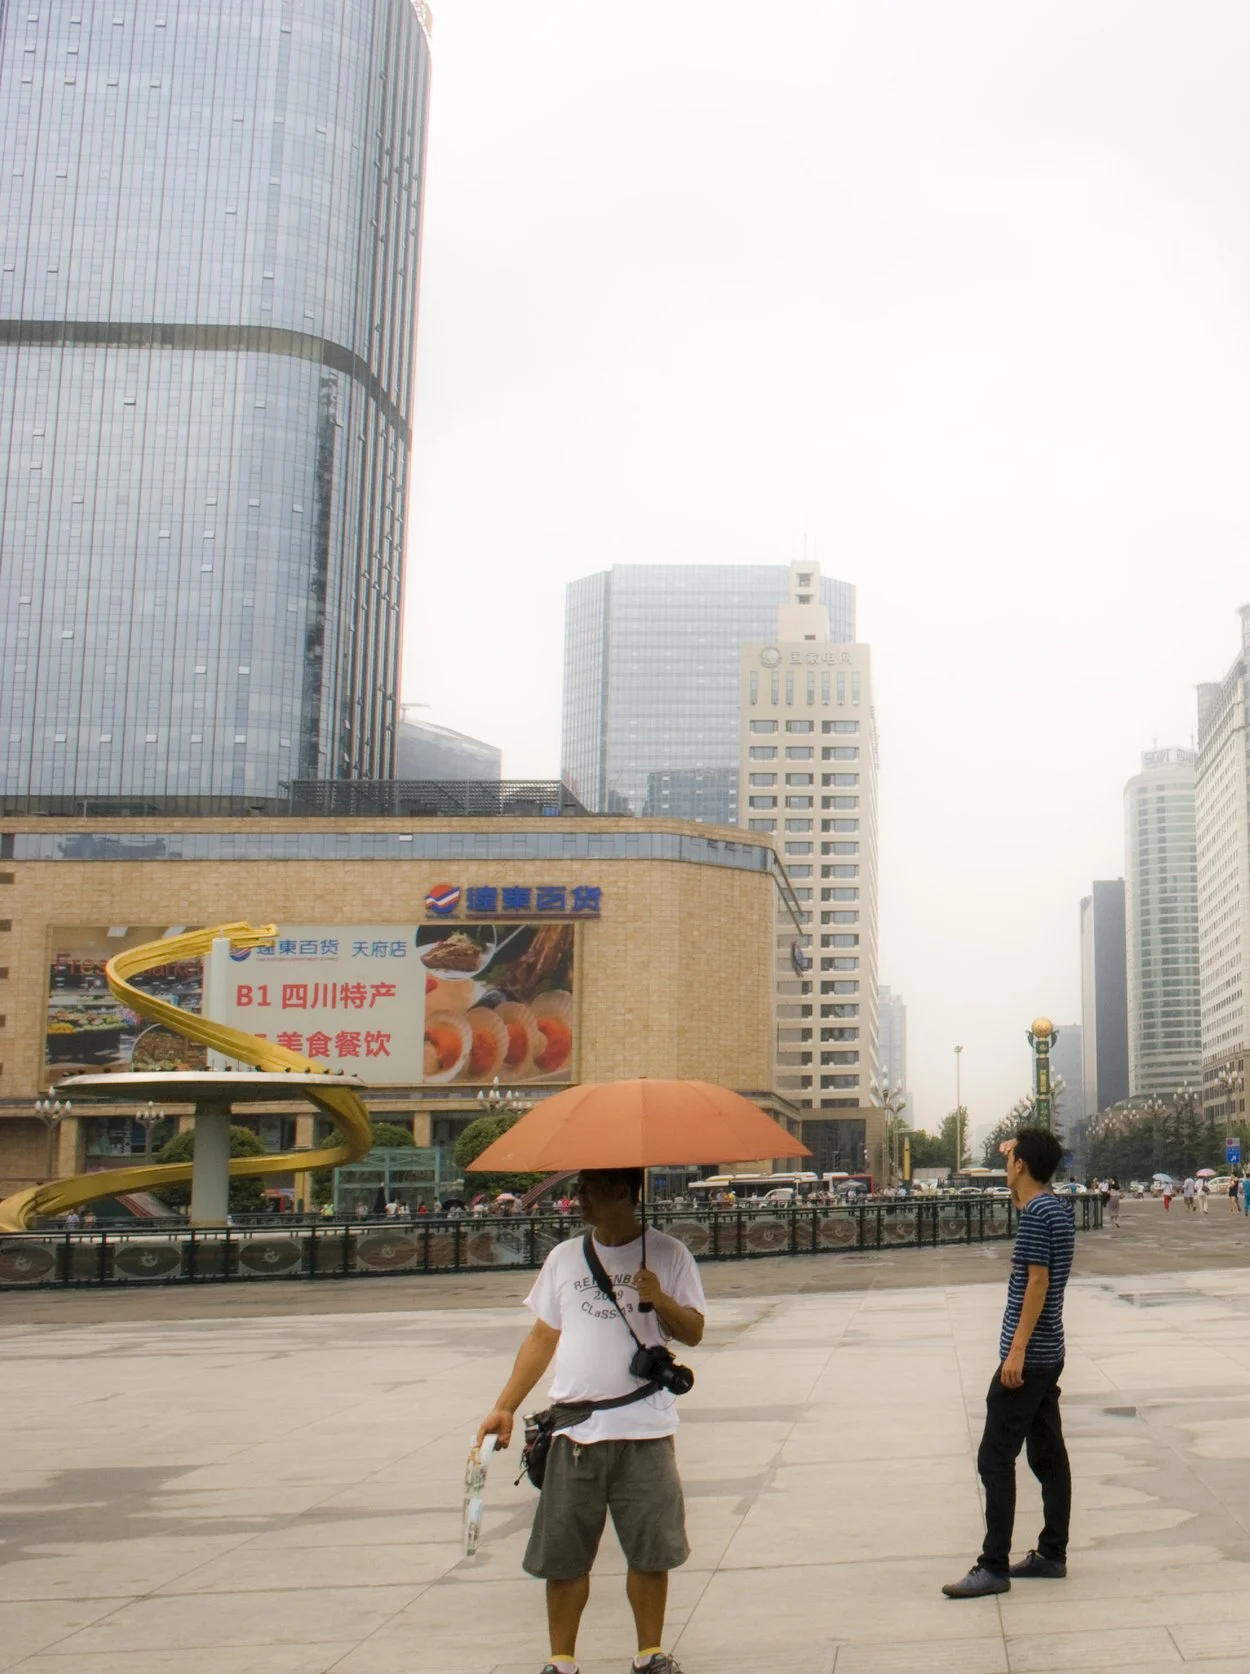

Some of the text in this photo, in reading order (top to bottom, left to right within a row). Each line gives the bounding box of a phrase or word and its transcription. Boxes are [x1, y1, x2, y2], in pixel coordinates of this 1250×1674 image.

[352, 941, 407, 957] 天府店
[55, 953, 117, 976] Fres
[236, 982, 396, 1009] B1 四川特产
[277, 1030, 391, 1058] 美食餐饮
[594, 1291, 624, 1301] 209
